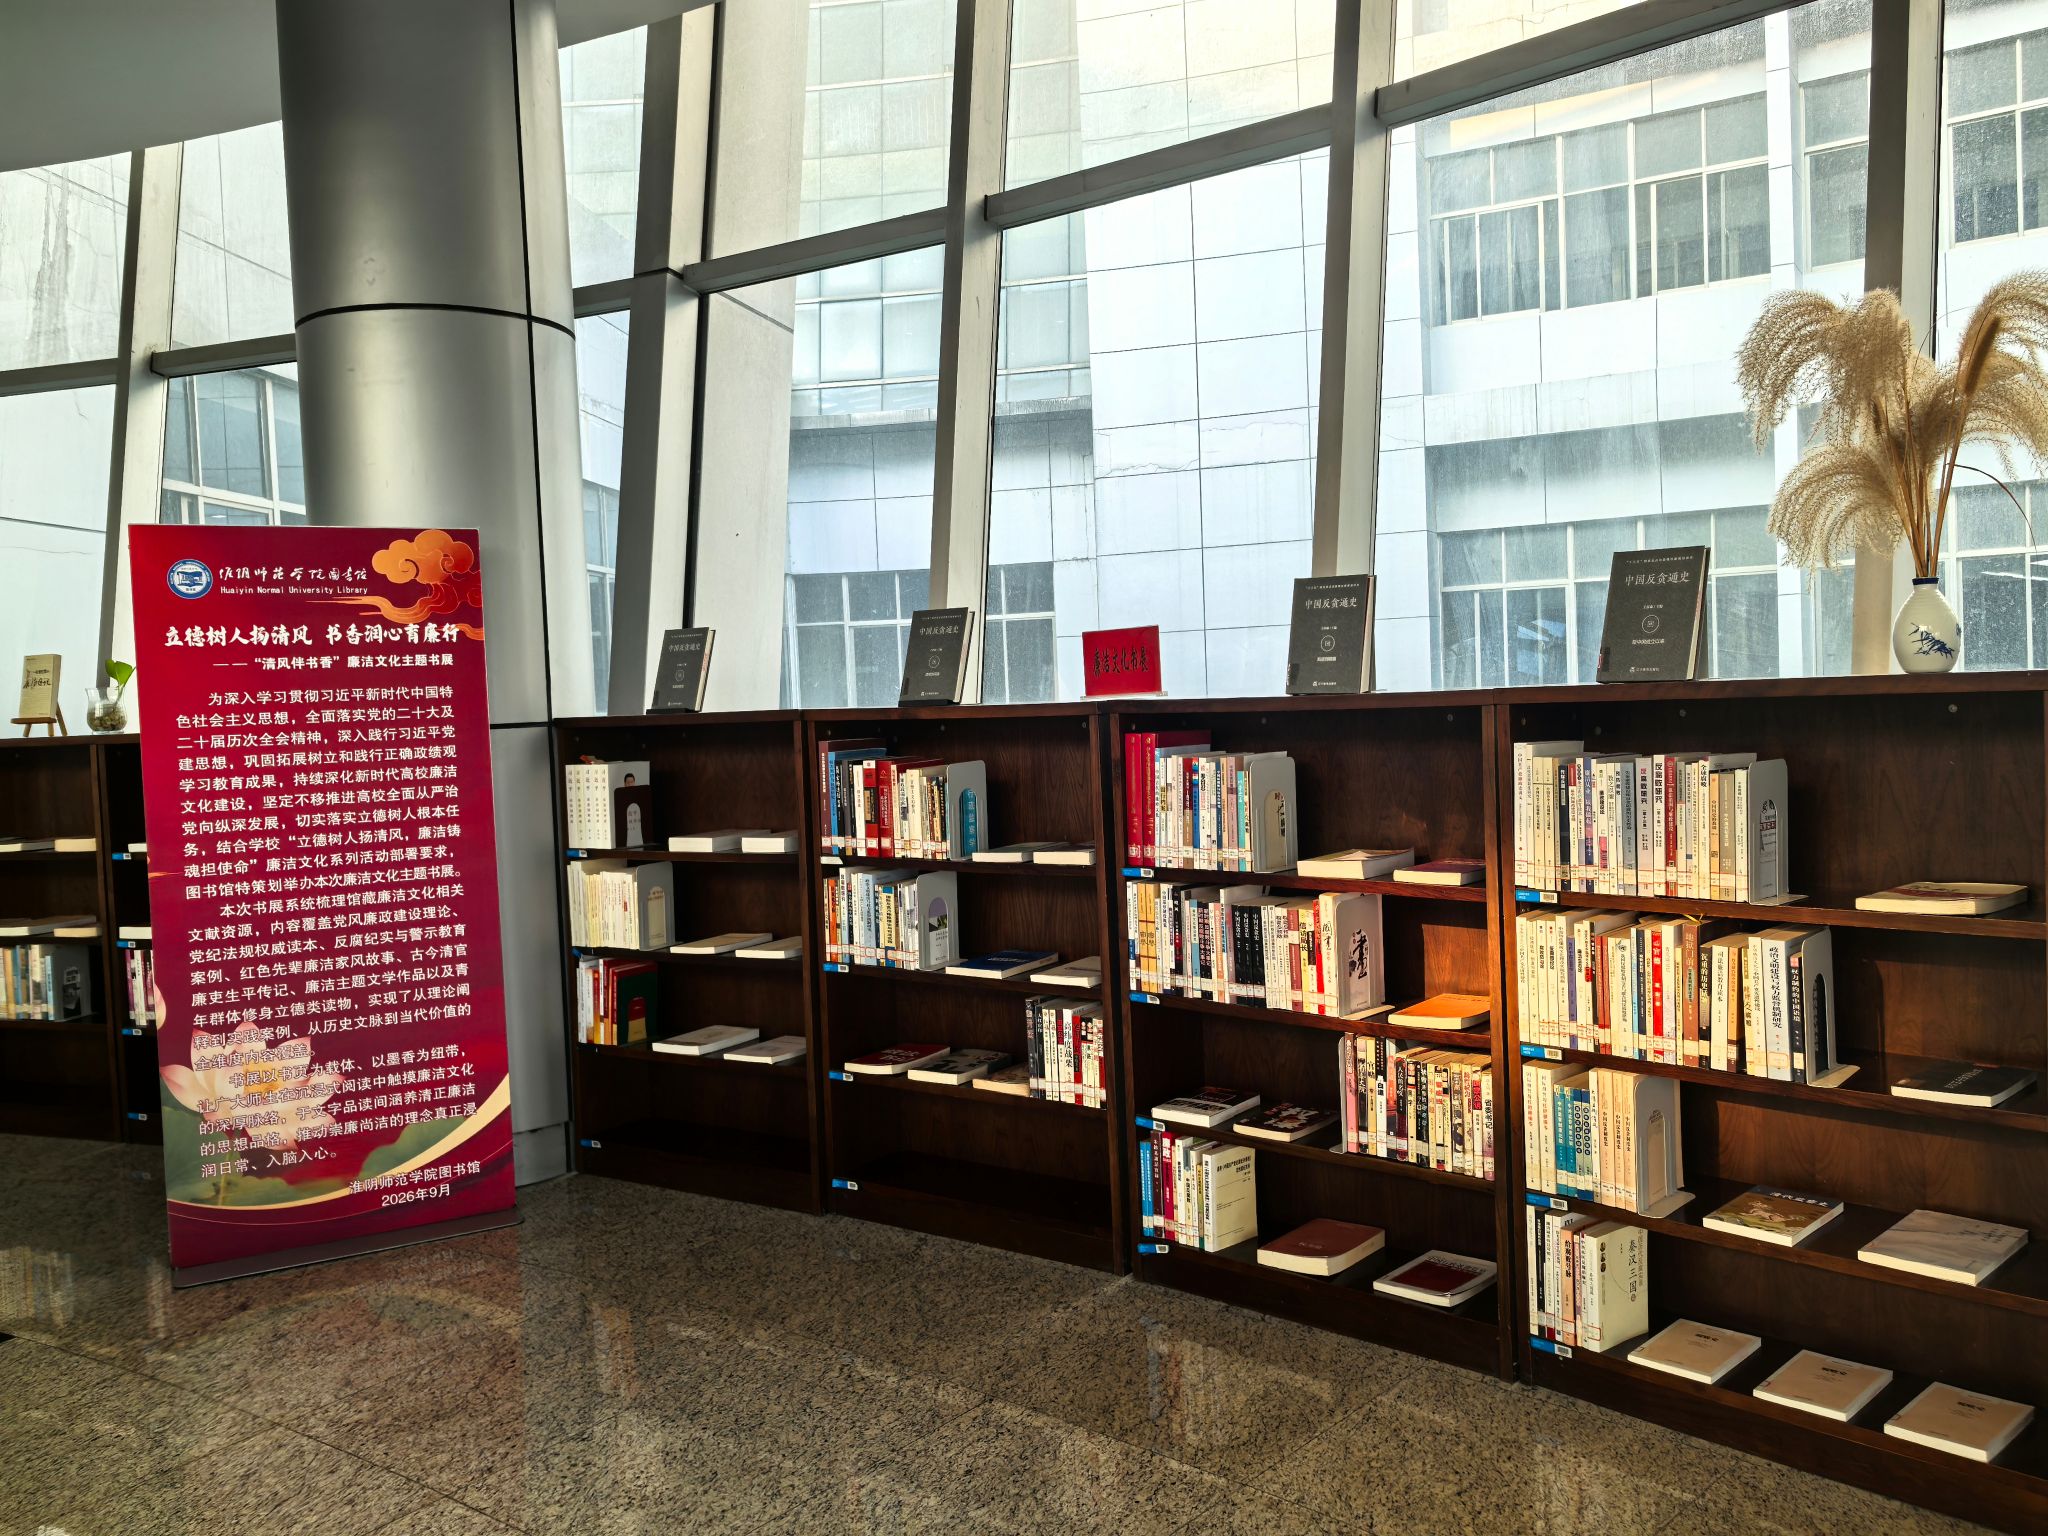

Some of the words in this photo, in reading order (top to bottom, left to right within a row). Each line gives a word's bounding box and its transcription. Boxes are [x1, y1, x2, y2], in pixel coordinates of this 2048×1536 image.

[221, 586, 254, 596] Huaiyin
[257, 586, 285, 595] Normal
[288, 586, 334, 597] University
[337, 586, 368, 596] Library
[164, 625, 313, 648] 立德树人扬清风
[325, 622, 460, 646] 书香润心育廉行
[208, 686, 454, 707] 为深入学习贯彻习近平新时代中国特
[185, 868, 461, 899] 图书馆特策划举办本次廉洁文化主题书展。
[220, 884, 464, 917] 本次书展系统梳理馆藏廉洁文化相关
[189, 924, 466, 964] 党纪法规权威读本、反腐纪实与警示教育
[190, 943, 468, 986] 案例、红色先辈廉洁家风故事、古今清官
[191, 963, 469, 1007] 廉吏生平传记、廉洁主题文学作品以及青
[194, 1003, 471, 1050] 释到实践案例、从历史文脉到当代价值的
[195, 1044, 314, 1071] 全维度内容覆盖。
[198, 1063, 474, 1114] 让广大师生在沉浸式阅读中触摸廉洁文化
[201, 1148, 337, 1178] 润日常、入脑入心。
[349, 1160, 481, 1195] 淮阴师范学院图书馆
[381, 1184, 450, 1207] 2026年9月
